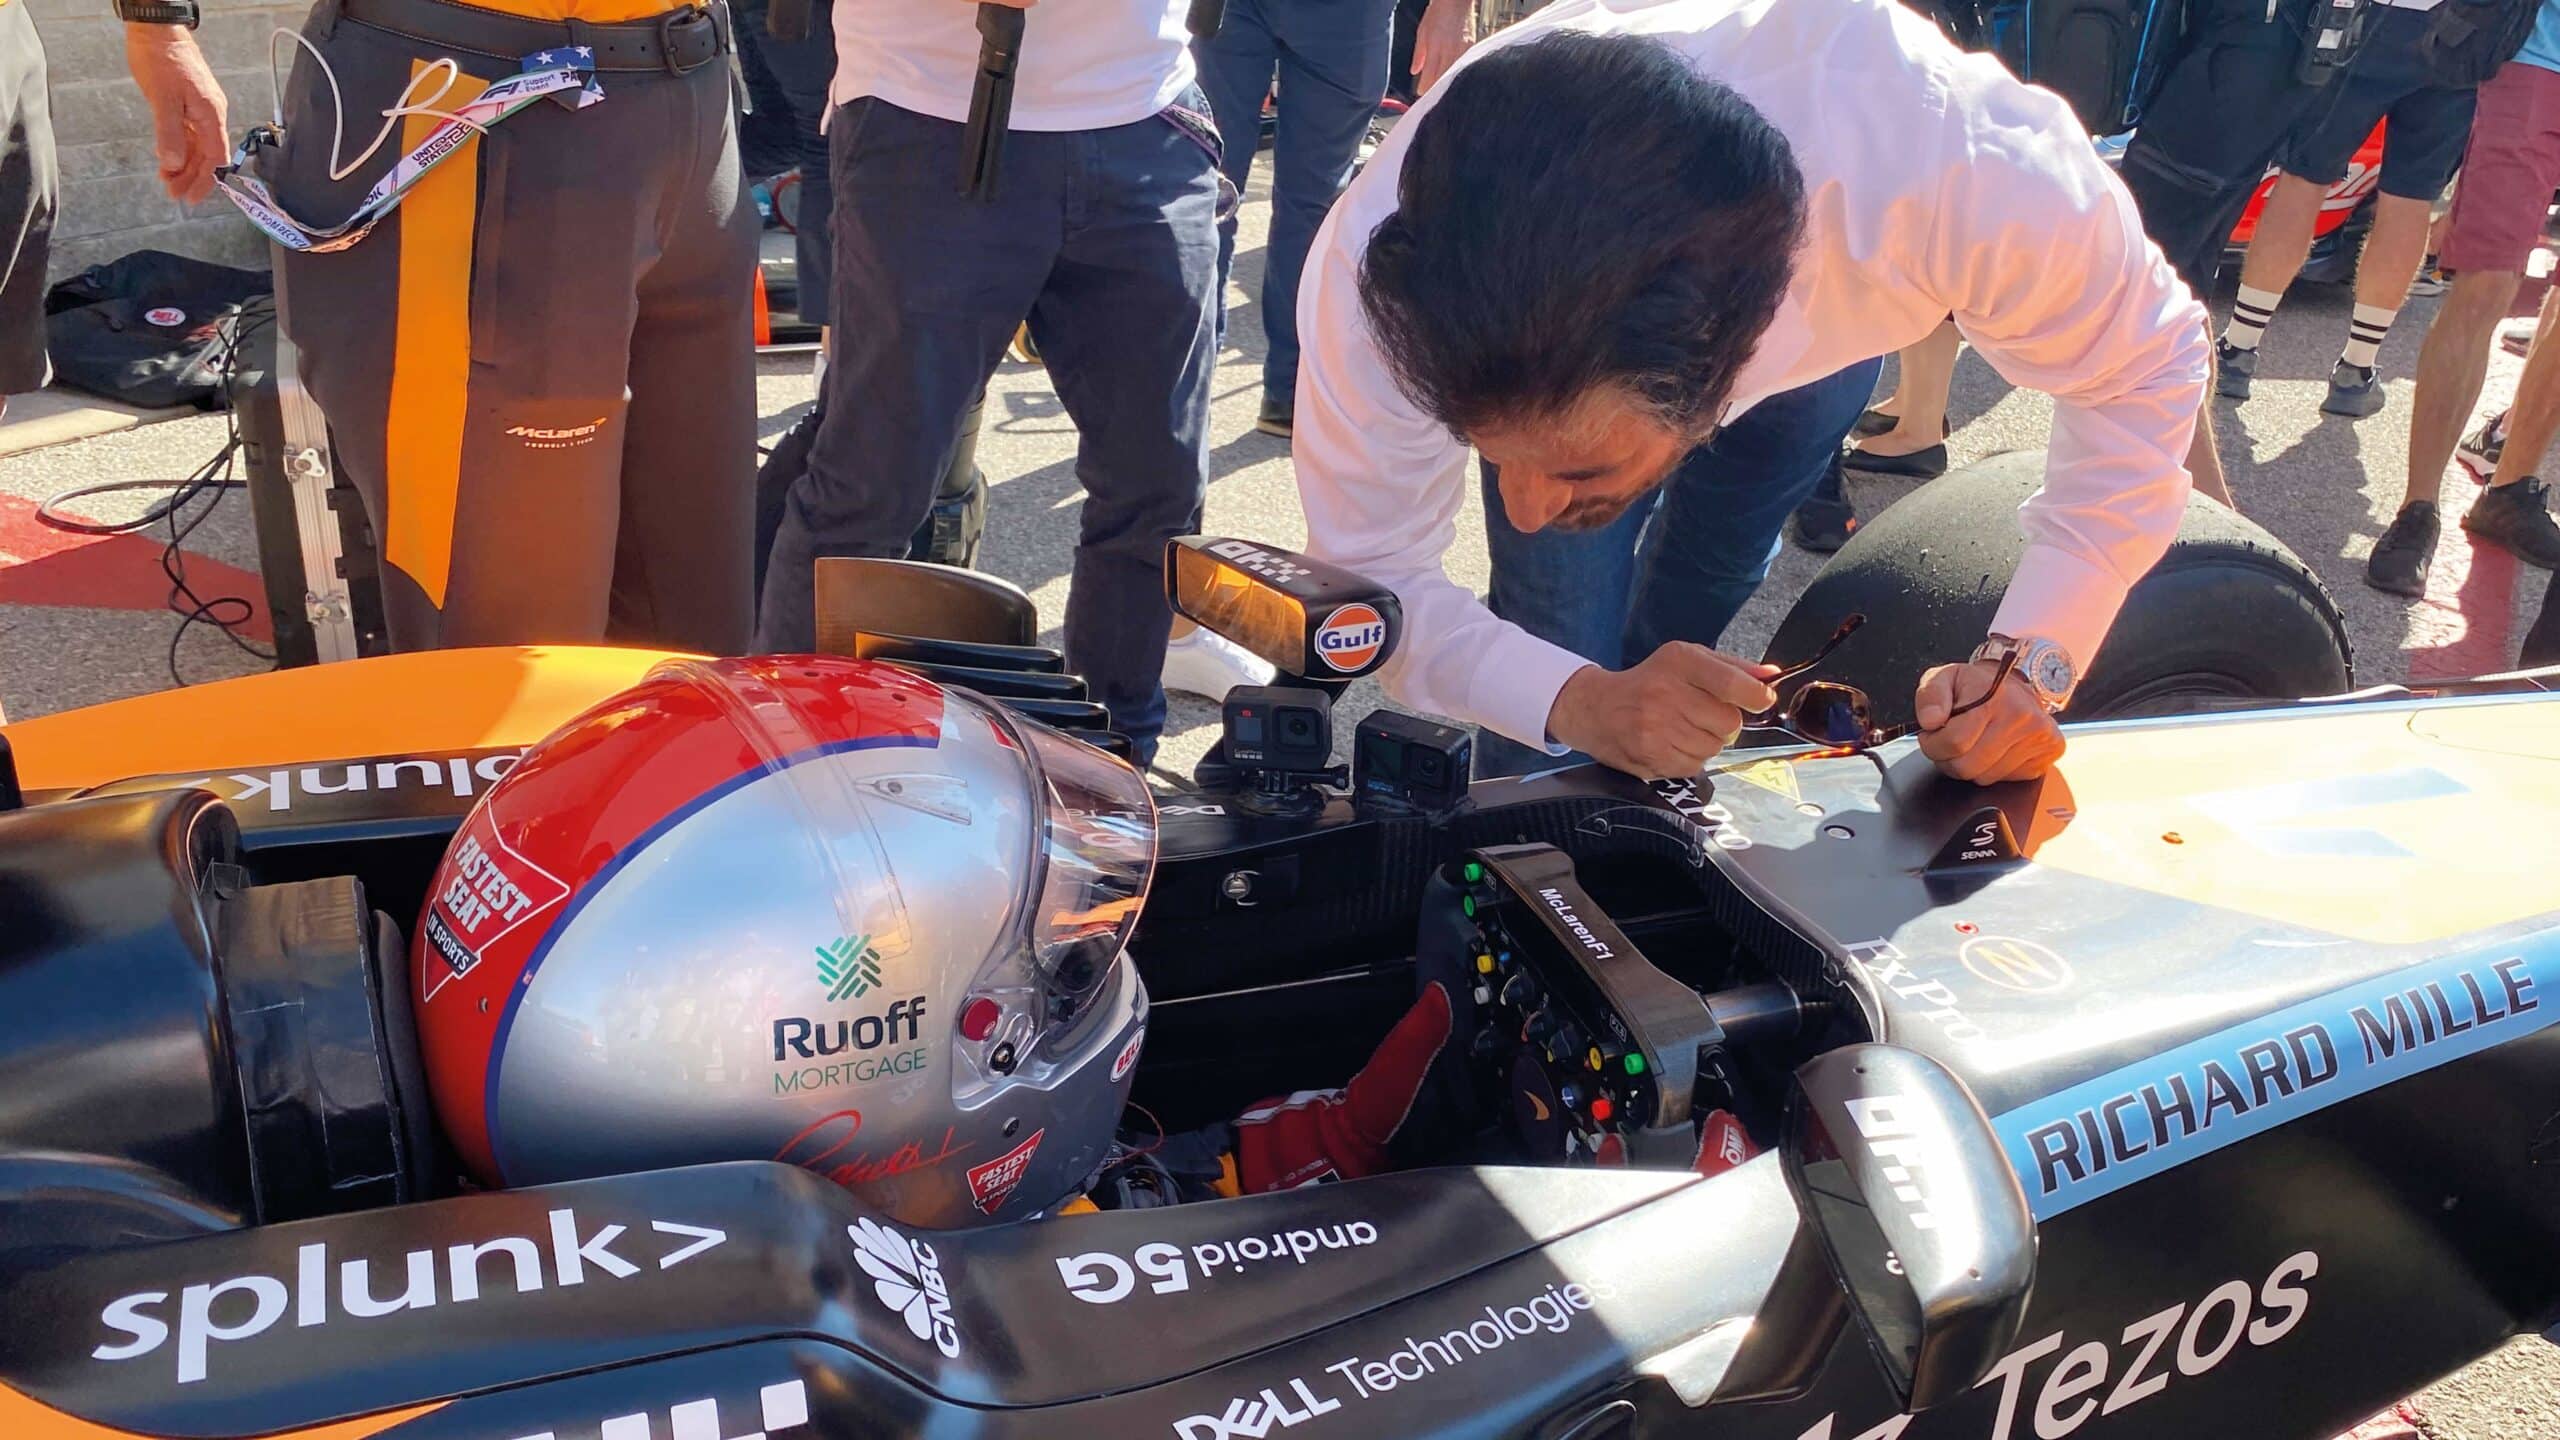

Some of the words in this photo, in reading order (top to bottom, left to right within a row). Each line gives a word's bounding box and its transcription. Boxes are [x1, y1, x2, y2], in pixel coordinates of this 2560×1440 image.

[412, 136, 448, 162] UNITED
[418, 141, 454, 168] STATES
[505, 423, 597, 439] McLaren
[1321, 625, 1382, 650] Gulf
[454, 834, 532, 922] FASTEST
[1960, 849, 1998, 860] SENNA
[443, 875, 491, 934] SEAT
[1538, 887, 1614, 960] McLarenF1
[427, 913, 439, 933] IN
[434, 927, 470, 971] SPORTS
[773, 996, 926, 1061] Ruoff
[1116, 1035, 1140, 1073] BELL
[774, 1048, 928, 1094] MORTGAGE
[2026, 1023, 2338, 1194] RICHARD
[2350, 957, 2538, 1065] MILLE
[976, 1146, 1034, 1186] FASTEST
[984, 1165, 1020, 1194] SEAT
[1055, 1243, 1190, 1304] 5G
[1193, 1220, 1378, 1277] android
[910, 1238, 960, 1358] CNBC
[1173, 1378, 1341, 1440] DELL
[1325, 1280, 1617, 1399] Technologies
[1973, 1251, 2319, 1440] Tezos
